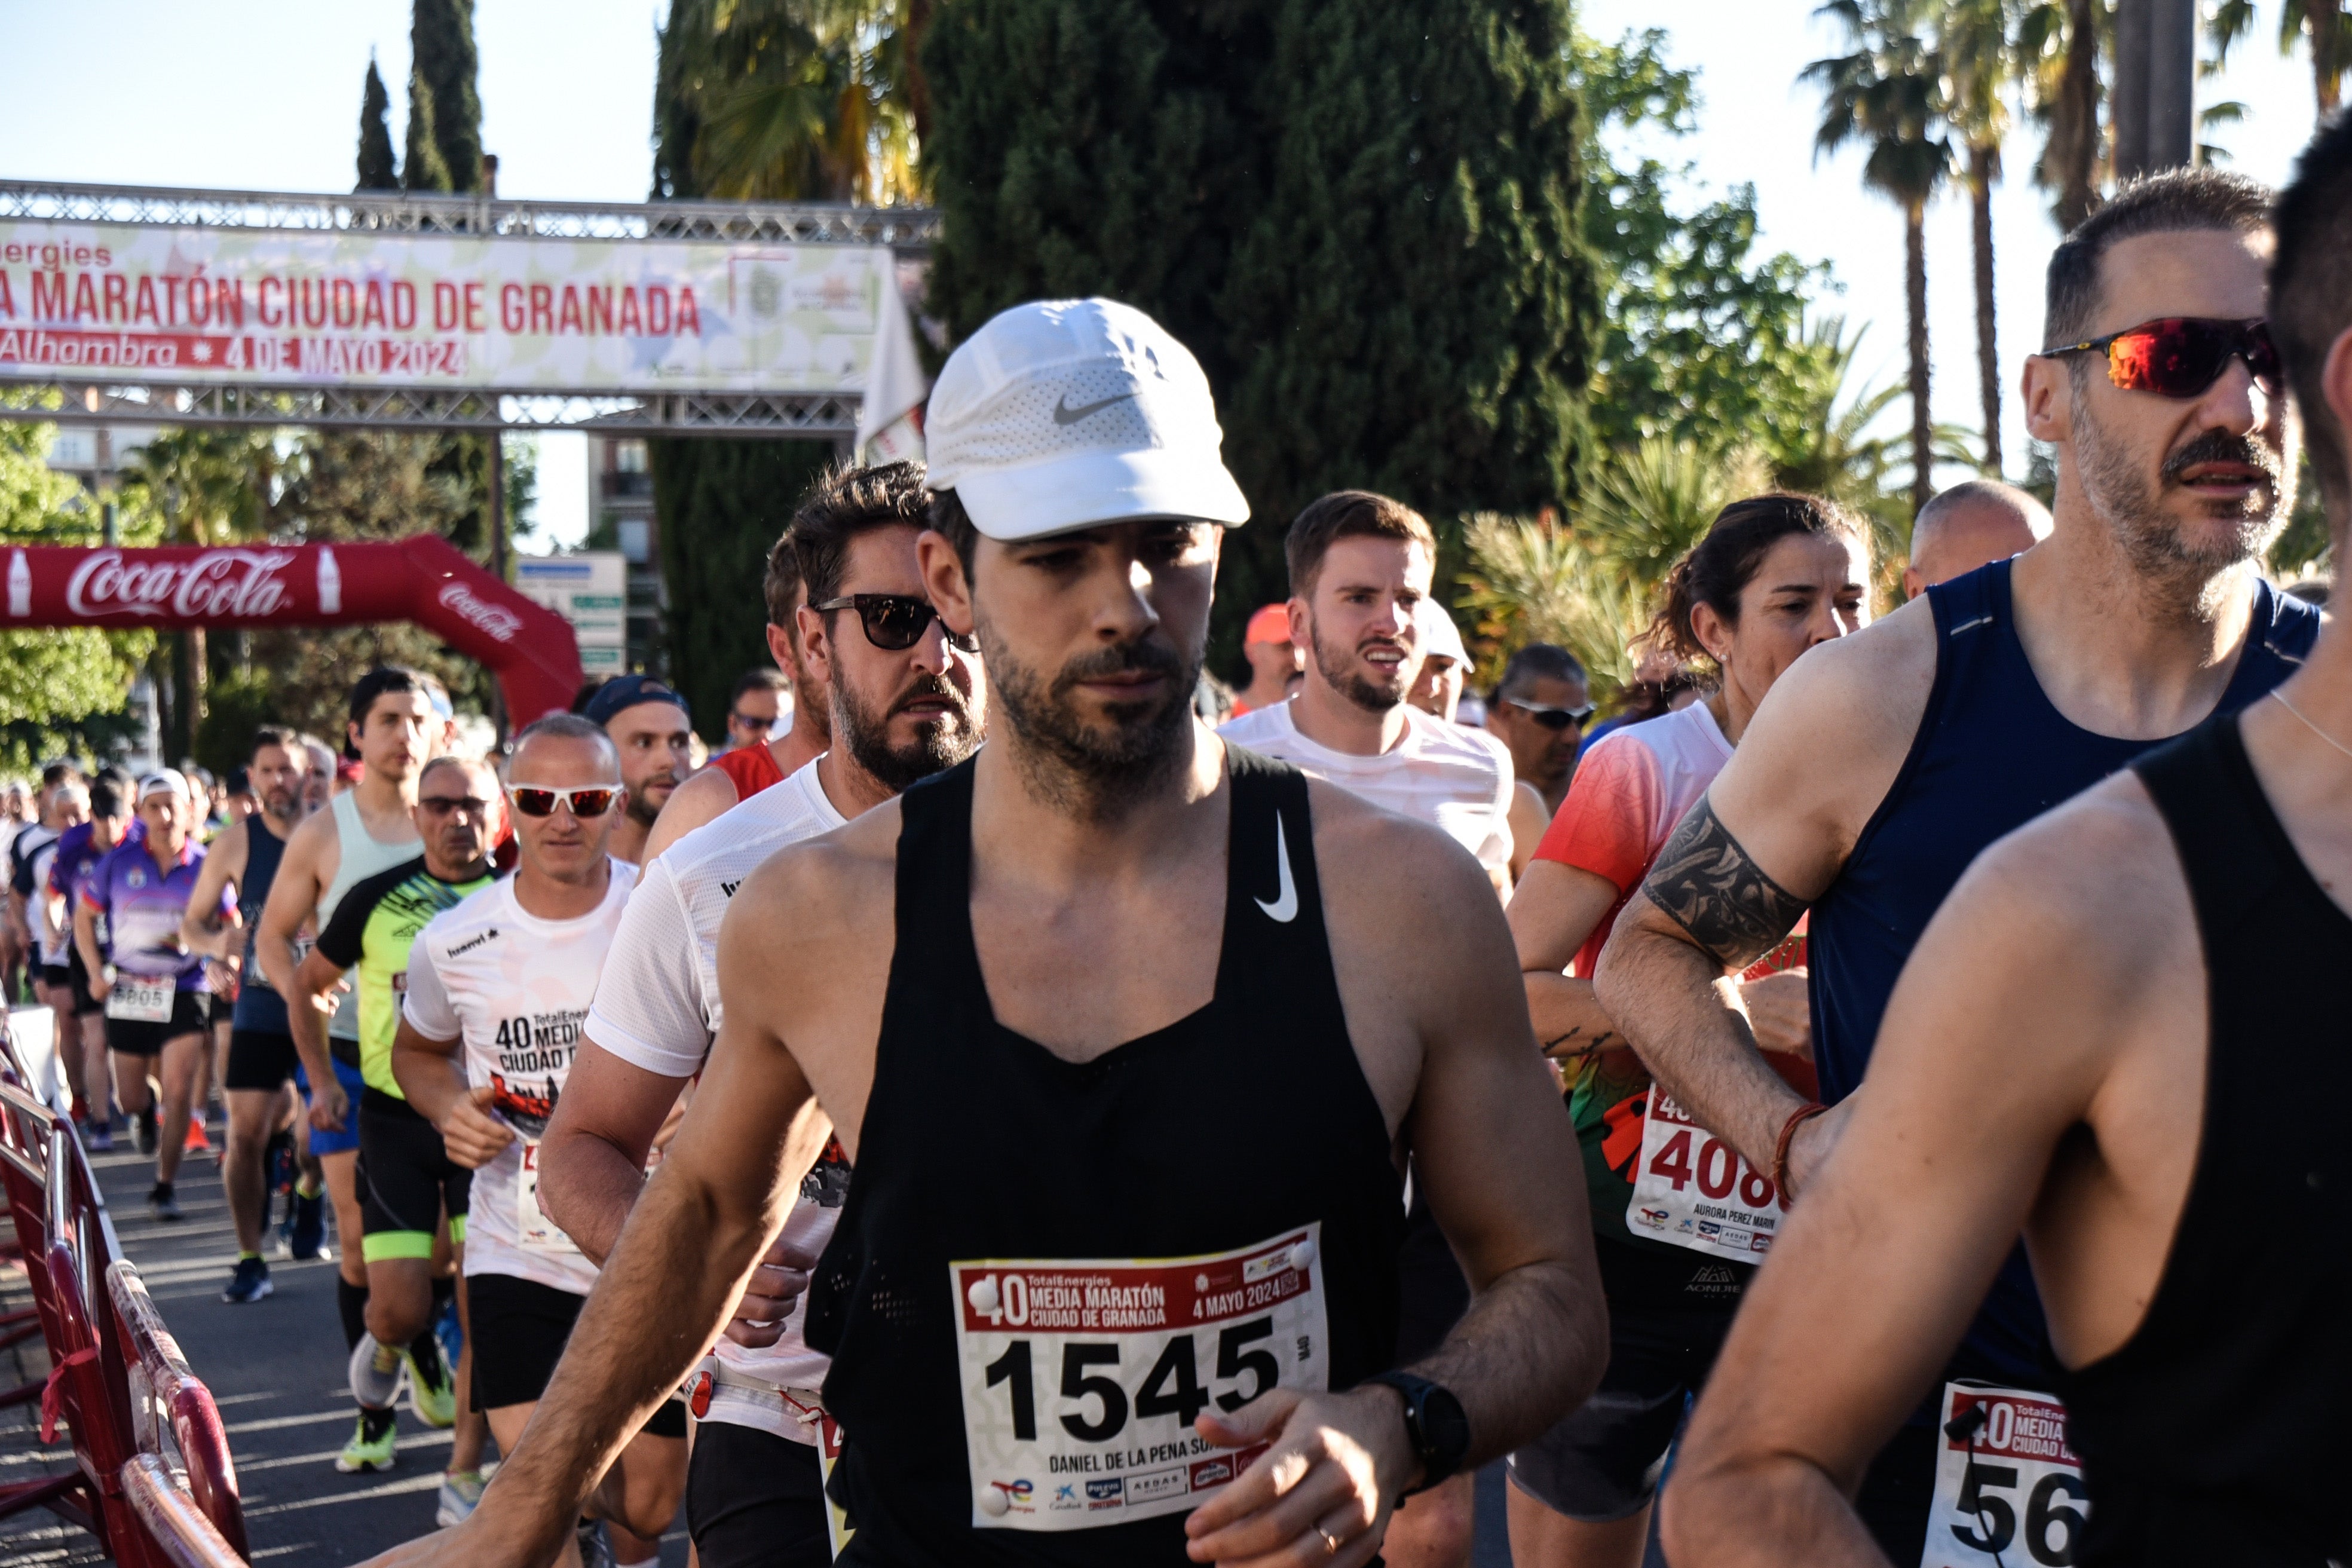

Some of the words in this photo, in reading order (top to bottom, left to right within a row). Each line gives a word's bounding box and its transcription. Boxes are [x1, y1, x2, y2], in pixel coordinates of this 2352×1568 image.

[32, 263, 244, 326] MARATÓN
[259, 276, 416, 330] CIUDAD
[433, 281, 485, 332] DE
[500, 283, 702, 337] GRANADA
[0, 330, 178, 367] Alhambra
[225, 337, 245, 368] 4
[255, 338, 290, 370] DE
[299, 338, 381, 373] MAYO
[390, 342, 468, 375] 2024
[67, 549, 295, 616] Coca-Cola
[439, 581, 523, 642] Coca-Cola
[447, 933, 486, 958] luanvi
[495, 1017, 531, 1051] 40
[499, 1049, 562, 1072] CIUDAD
[1649, 1129, 1791, 1214] 408
[1693, 1203, 1727, 1220] AURORA
[1728, 1212, 1752, 1225] PEREZ
[1753, 1215, 1775, 1231] MARIN
[1028, 1275, 1112, 1288] TotalEnergies
[1029, 1286, 1082, 1309] MEDIA
[1084, 1282, 1165, 1309] MARATÓN
[1193, 1298, 1203, 1319] 4
[1205, 1290, 1245, 1317] MAYO
[1247, 1278, 1281, 1307] 2024
[1030, 1309, 1079, 1327] CIUDAD
[1082, 1309, 1100, 1327] DE
[1101, 1308, 1166, 1327] GRANADA
[985, 1316, 1279, 1443] 1545
[2014, 1416, 2063, 1441] MEDIA
[1049, 1453, 1101, 1474] DANIEL
[1105, 1450, 1124, 1470] DE
[1127, 1448, 1146, 1468] LA
[1149, 1441, 1187, 1464] PENA
[1190, 1437, 1213, 1456] SU
[2011, 1435, 2058, 1458] CIUDAD
[1950, 1462, 2091, 1567] 56
